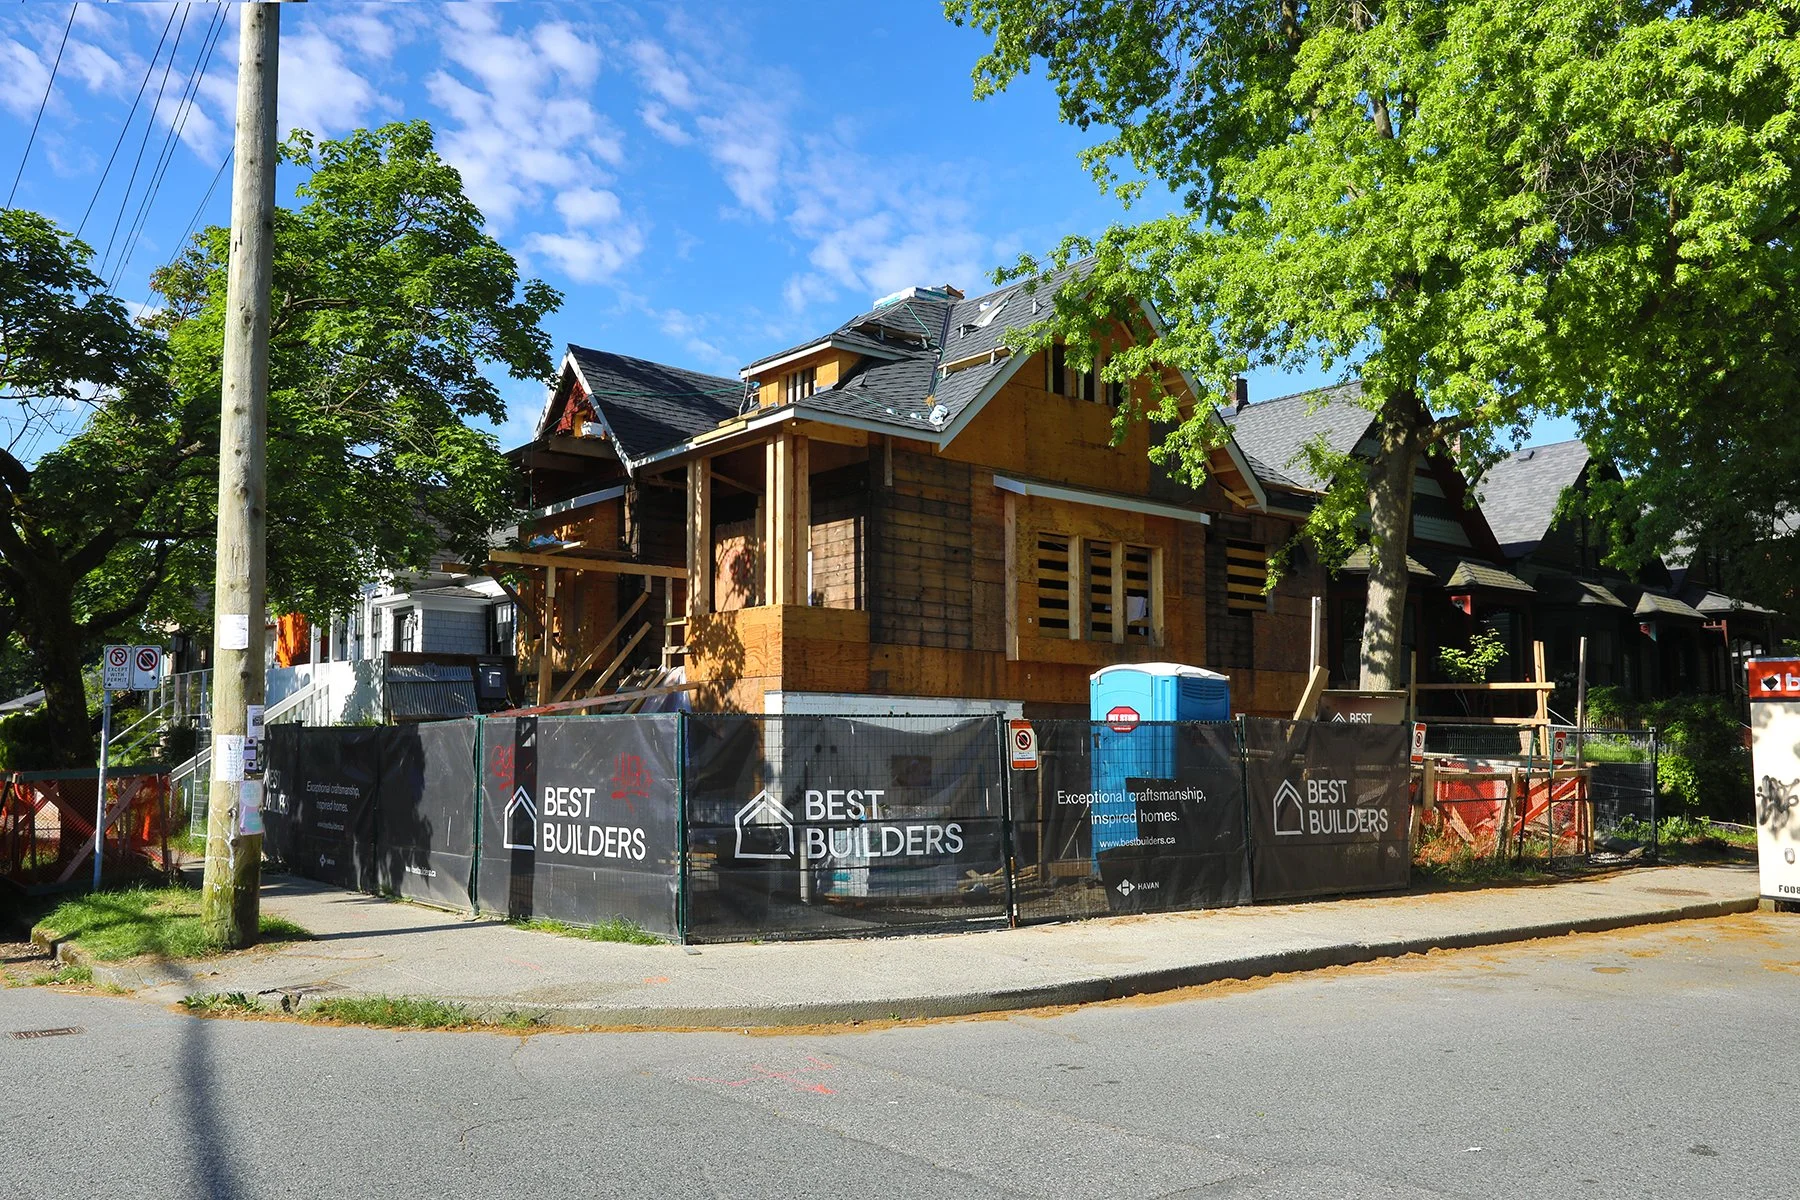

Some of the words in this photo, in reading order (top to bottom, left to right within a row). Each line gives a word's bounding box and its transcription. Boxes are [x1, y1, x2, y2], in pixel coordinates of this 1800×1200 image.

[1349, 712, 1372, 724] BEST
[544, 786, 596, 818] BEST
[1057, 789, 1126, 808] Exceptional
[1128, 786, 1206, 804] craftsmanship,
[1307, 779, 1347, 804] BEST
[805, 789, 885, 821] BEST
[1091, 810, 1137, 827] inspired
[1140, 809, 1180, 823] homes.
[1308, 808, 1389, 835] BUILDERS
[543, 823, 646, 861] BUILDERS
[806, 823, 964, 859] BUILDERS
[1100, 837, 1176, 848] www.bestbuilders.ca
[1137, 882, 1160, 890] HAVAN
